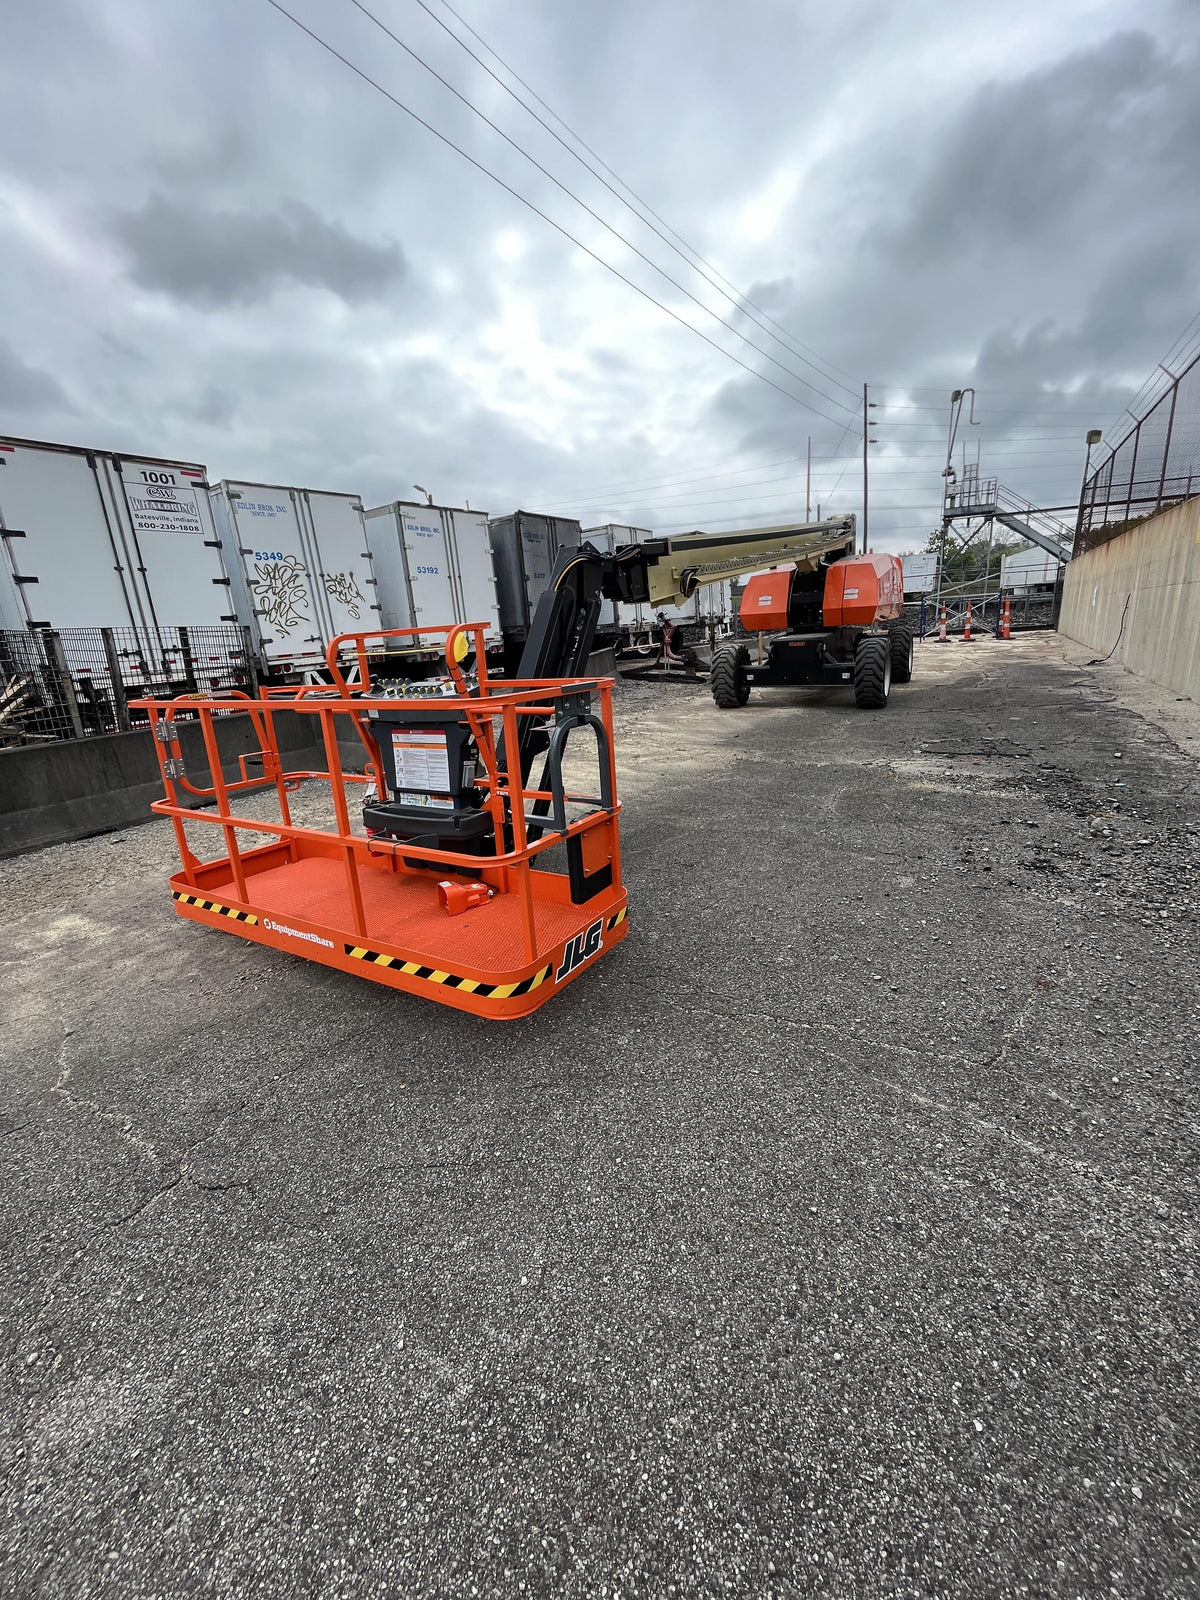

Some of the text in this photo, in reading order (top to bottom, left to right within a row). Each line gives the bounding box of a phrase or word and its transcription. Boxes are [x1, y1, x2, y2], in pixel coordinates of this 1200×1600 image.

[140, 471, 176, 485] 1001
[134, 513, 199, 524] Batesville, Indiana
[137, 522, 200, 531] 800-230-1808
[255, 552, 283, 561] 5349
[417, 566, 439, 575] 53192
[271, 921, 335, 949] EquipmentShare
[555, 917, 604, 985] JLG
